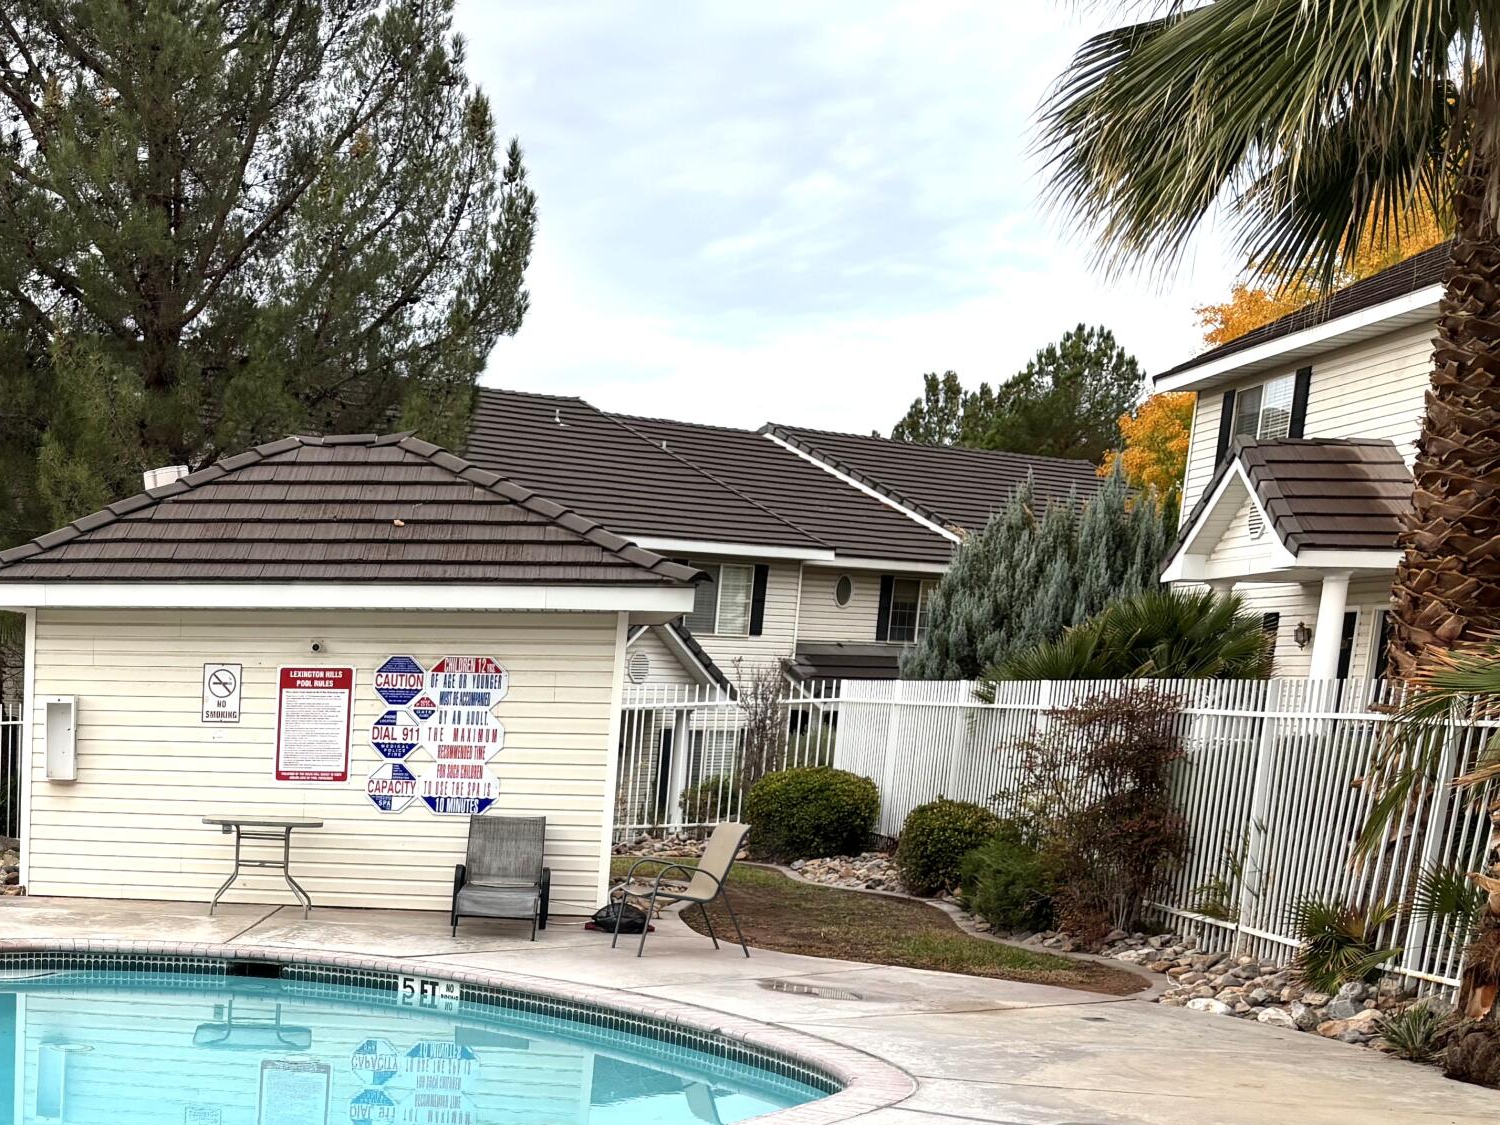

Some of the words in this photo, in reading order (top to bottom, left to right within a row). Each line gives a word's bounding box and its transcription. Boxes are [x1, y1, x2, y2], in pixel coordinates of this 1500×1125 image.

[444, 657, 476, 673] CHILDREN
[478, 658, 487, 673] 12
[375, 673, 424, 687] CAUTION
[431, 673, 438, 688] OF
[443, 673, 456, 688] AGE
[459, 674, 467, 688] OR
[473, 674, 502, 689] YOUNGER
[217, 700, 226, 708] NO
[439, 691, 452, 705] MUST
[453, 691, 459, 706] BE
[460, 692, 491, 706] ACCOMPANIED
[439, 710, 447, 724] BY
[452, 710, 461, 724] AN
[372, 726, 397, 740] DIAL
[402, 727, 420, 741] 911
[428, 727, 443, 741] THE
[453, 728, 497, 742] MAXIMUM
[437, 745, 473, 759] RECOMMENDED
[474, 746, 486, 760] TIME
[437, 764, 446, 778] FOR
[447, 764, 460, 778] SUCH
[460, 765, 483, 779] CHILDREN
[367, 780, 416, 794] CAPACITY
[424, 781, 432, 795] TO
[435, 781, 448, 795] USE
[452, 782, 464, 796] THE
[467, 782, 480, 796] SPA
[484, 782, 491, 796] IS
[435, 798, 444, 812] 10
[446, 798, 479, 813] MINUTES
[420, 980, 439, 996] FT
[446, 984, 454, 993] NO
